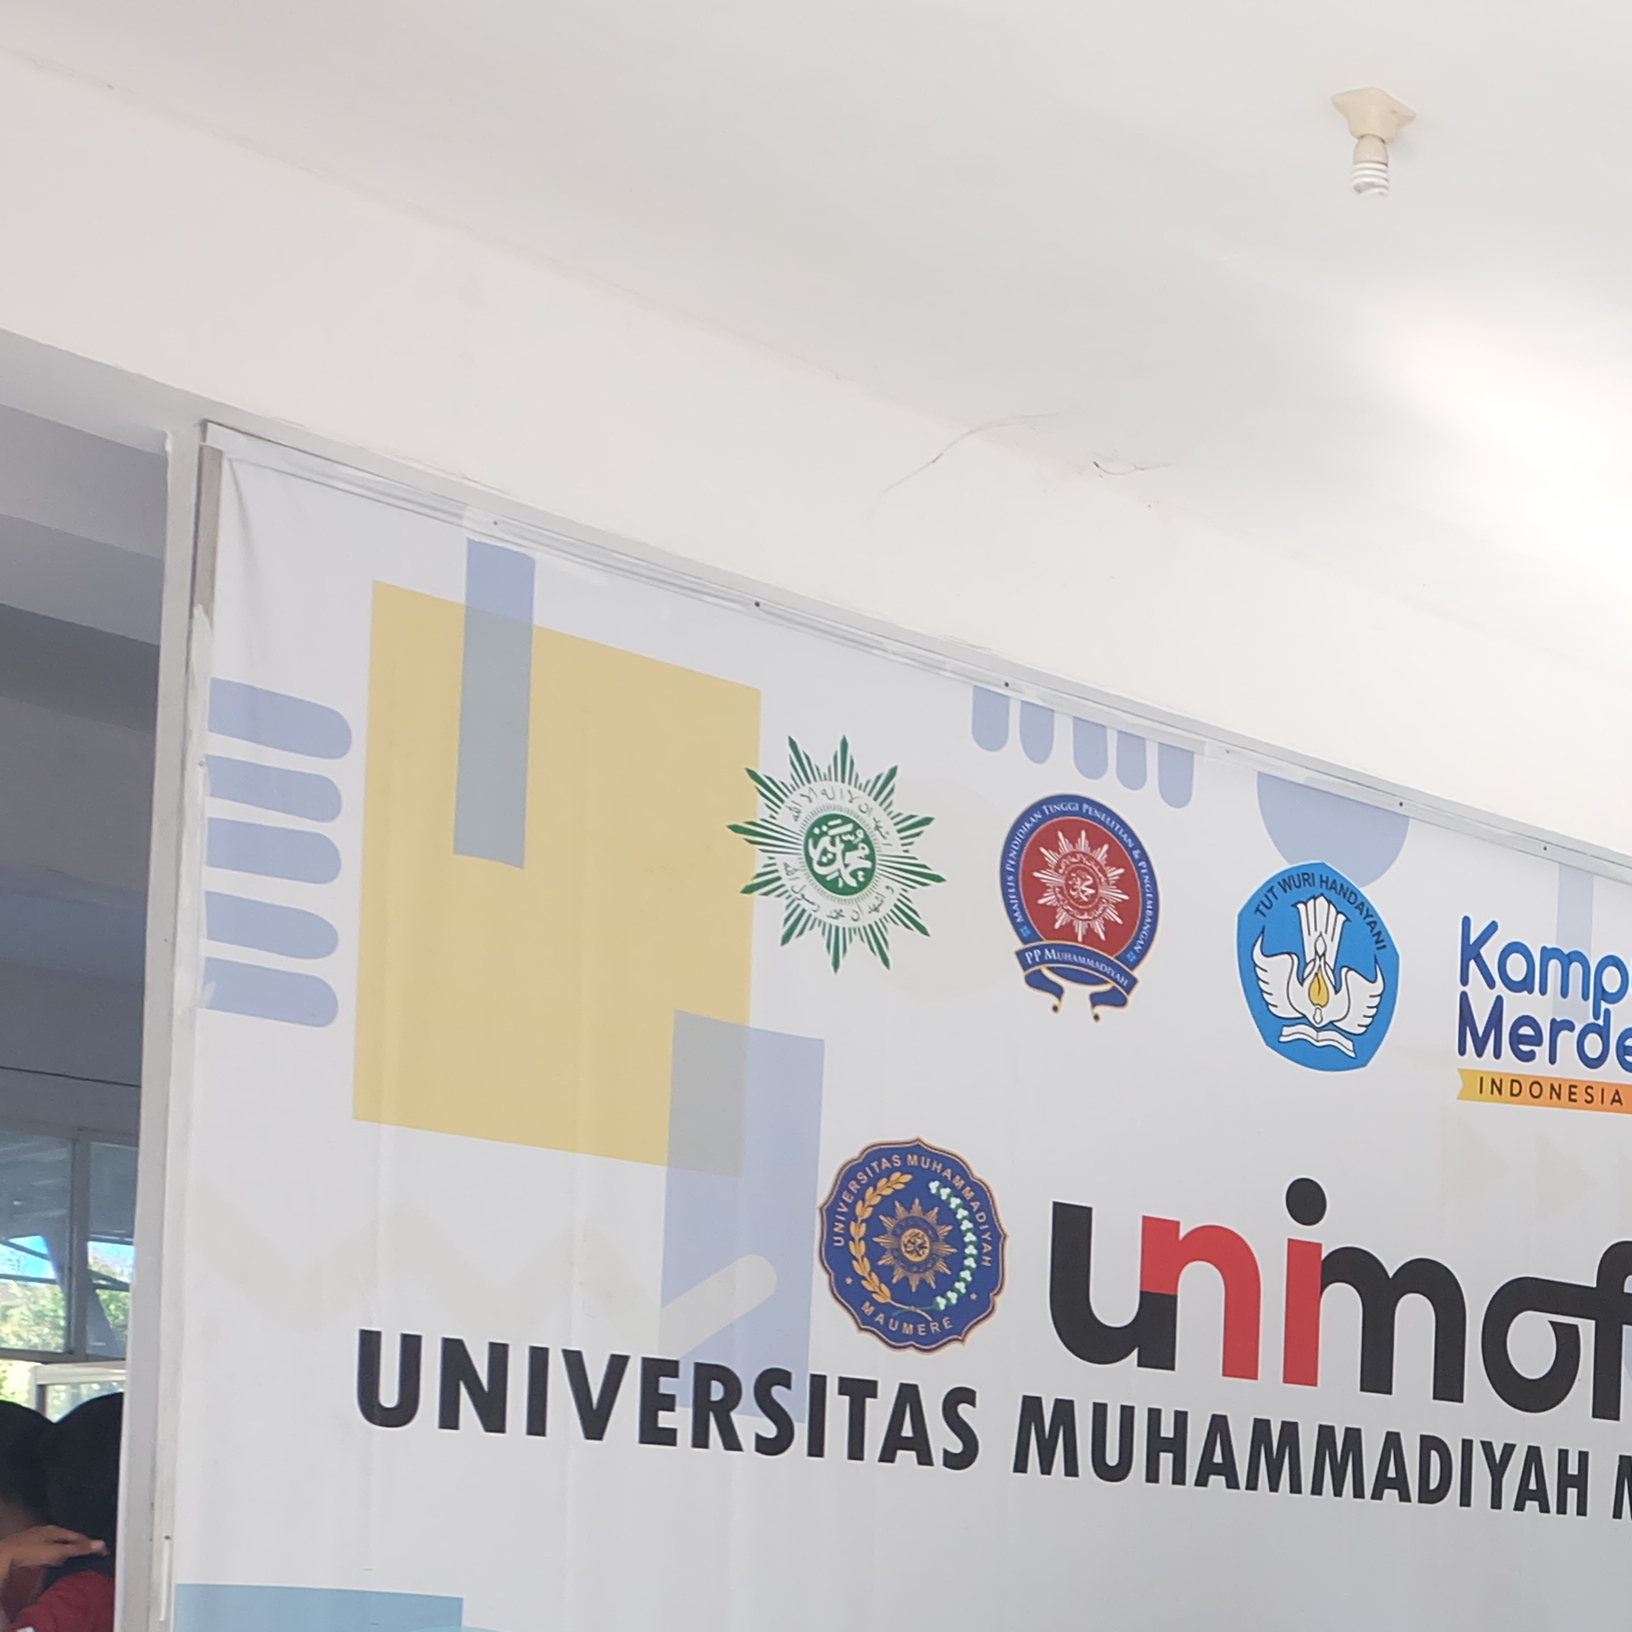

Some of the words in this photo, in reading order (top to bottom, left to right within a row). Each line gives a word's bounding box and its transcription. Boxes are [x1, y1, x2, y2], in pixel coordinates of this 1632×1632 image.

[1005, 811, 1043, 872] PENDIDIKAN
[1043, 801, 1080, 815] TINGGI
[1082, 802, 1135, 848] PENELITIAN
[1134, 861, 1154, 953] PENGEMBANGAN
[1253, 886, 1280, 920] TUT
[1277, 872, 1316, 893] WURI
[1319, 872, 1388, 952] HANDAYANI
[1025, 949, 1042, 965] PP
[1478, 1075, 1625, 1108] INDONESIA
[833, 1154, 902, 1248] UNIVERSITAS
[906, 1153, 994, 1268] MUHAMMADIYAH
[861, 1300, 954, 1337] MAUMERE
[355, 1327, 981, 1472] UNIVERSITAS
[1011, 1393, 1592, 1518] MUHAMMADIYAH
